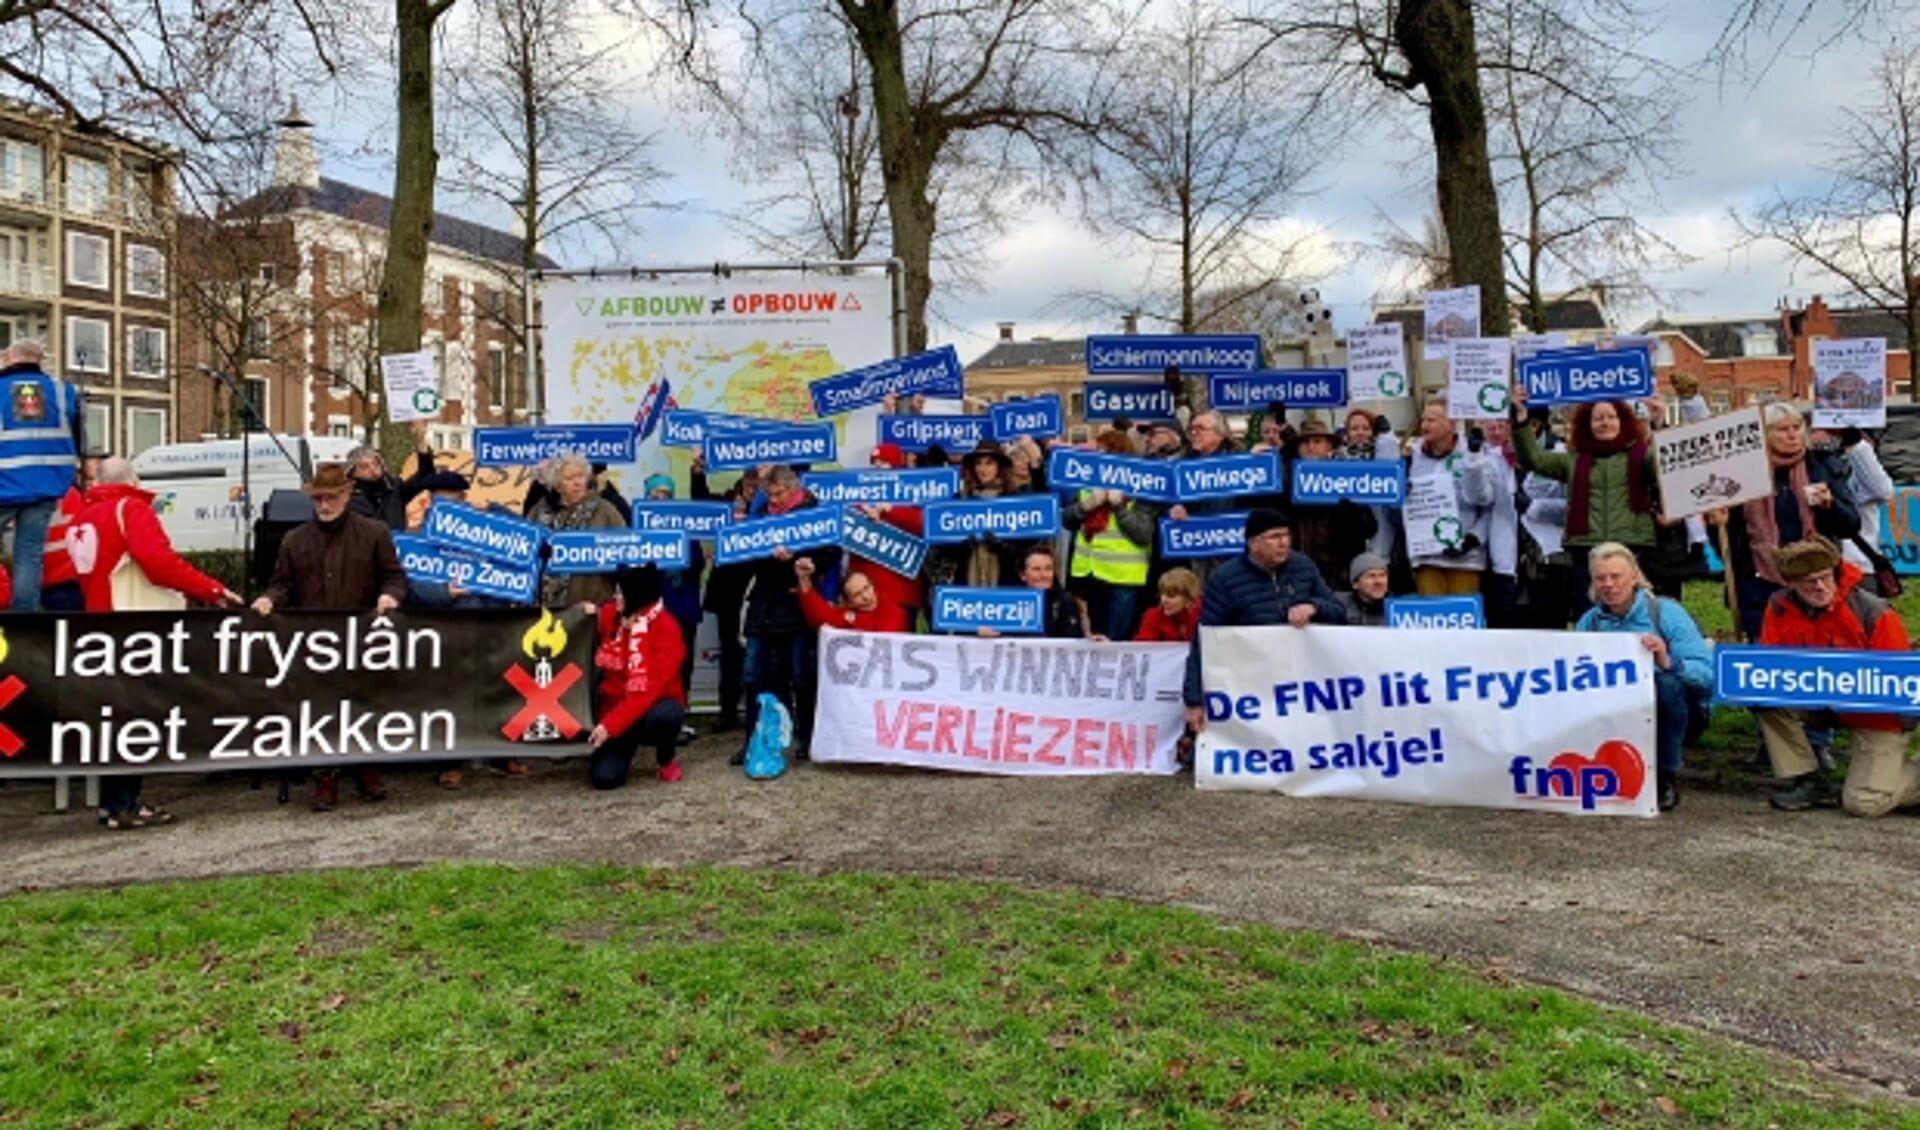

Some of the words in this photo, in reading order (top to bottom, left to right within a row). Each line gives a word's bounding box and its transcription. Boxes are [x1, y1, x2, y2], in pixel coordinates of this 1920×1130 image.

[600, 296, 704, 317] AFBOUW
[732, 292, 836, 314] OPBOUW
[1094, 346, 1254, 370] Schiermonnikoog
[1224, 381, 1331, 405] Nijensleek
[1530, 369, 1562, 398] Nij
[1569, 365, 1641, 392] Beets
[1090, 389, 1175, 416] Gasvrij
[892, 419, 983, 444] Grijpskerk
[1005, 411, 1048, 431] Faan
[482, 440, 632, 460] Ferwerderadeel
[714, 436, 825, 462] Waddenzee
[1065, 458, 1093, 480] De
[1100, 462, 1166, 492] Wilgen
[1185, 465, 1267, 493] Vinkega
[1300, 472, 1398, 494] Woerden
[434, 511, 531, 558] Waalwijk
[641, 510, 726, 531] Ternaard
[939, 509, 1043, 532] Groningen
[552, 540, 683, 565] Dongeradeel
[446, 561, 475, 586] op
[477, 563, 528, 590] Zand
[943, 598, 1035, 627] Pieterzijl
[53, 618, 190, 677] laat
[214, 615, 442, 687] fryslân
[825, 634, 939, 692] GAS
[1205, 690, 1261, 723] De
[1275, 676, 1364, 717] FNP
[1380, 671, 1431, 709] lit
[1445, 654, 1638, 709] Fryslân
[1733, 662, 1920, 704] Terschelling
[51, 706, 187, 764] niet
[209, 700, 456, 759] zakken
[1213, 746, 1294, 775] nea
[1308, 727, 1446, 778] sakje!
[1509, 755, 1618, 809] fnp
